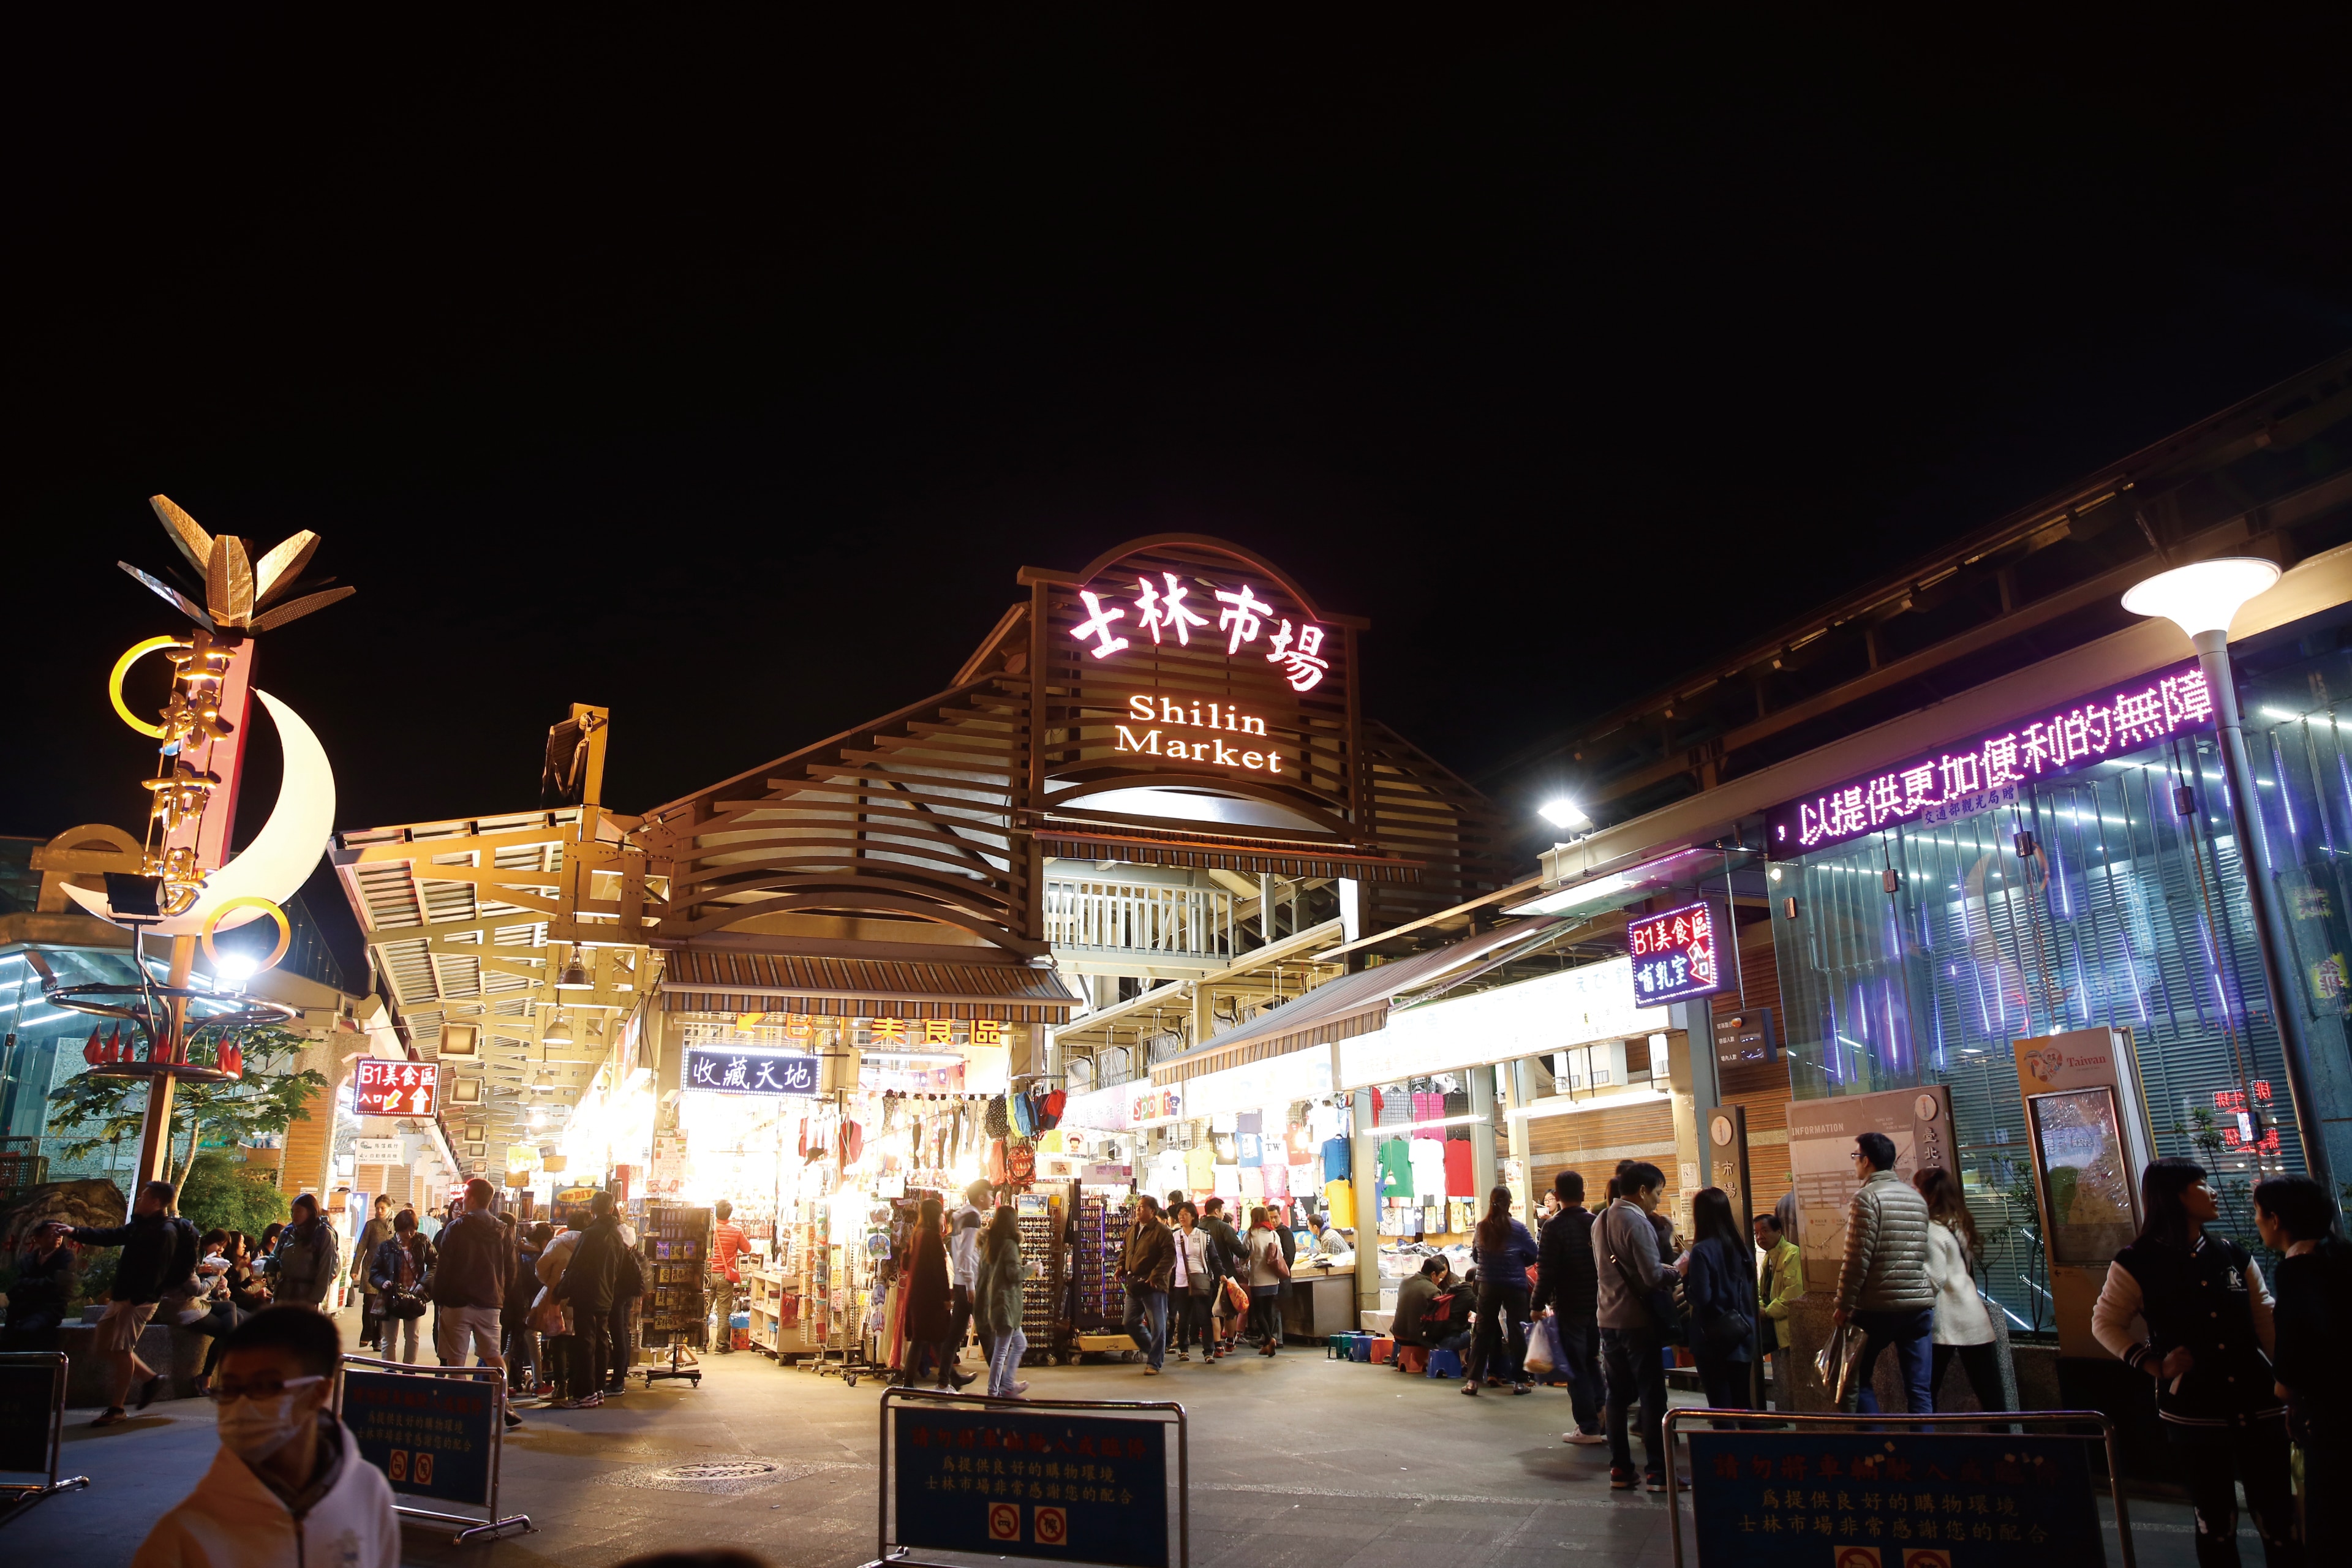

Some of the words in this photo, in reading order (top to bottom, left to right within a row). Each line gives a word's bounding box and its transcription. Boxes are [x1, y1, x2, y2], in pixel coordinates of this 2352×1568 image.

[1069, 571, 1329, 692] 士林市場
[1129, 694, 1268, 736] Shilin
[1114, 725, 1283, 774] Market
[1923, 784, 2016, 826] 交通部觀光局贈
[1633, 910, 1710, 956] B1美食區
[361, 1064, 435, 1087] B1美食區
[693, 1055, 812, 1090] 收藏天地
[2067, 1055, 2107, 1068] Taiwan
[358, 1093, 382, 1104] 入口
[1134, 1093, 1170, 1121] Sport
[1791, 1122, 1844, 1136] INFORMATION
[1923, 1126, 1941, 1169] 臺北
[924, 1475, 1134, 1505] 士林市場非常感謝您的配合
[1738, 1514, 2049, 1545] 士林市場非常感謝您的配合
